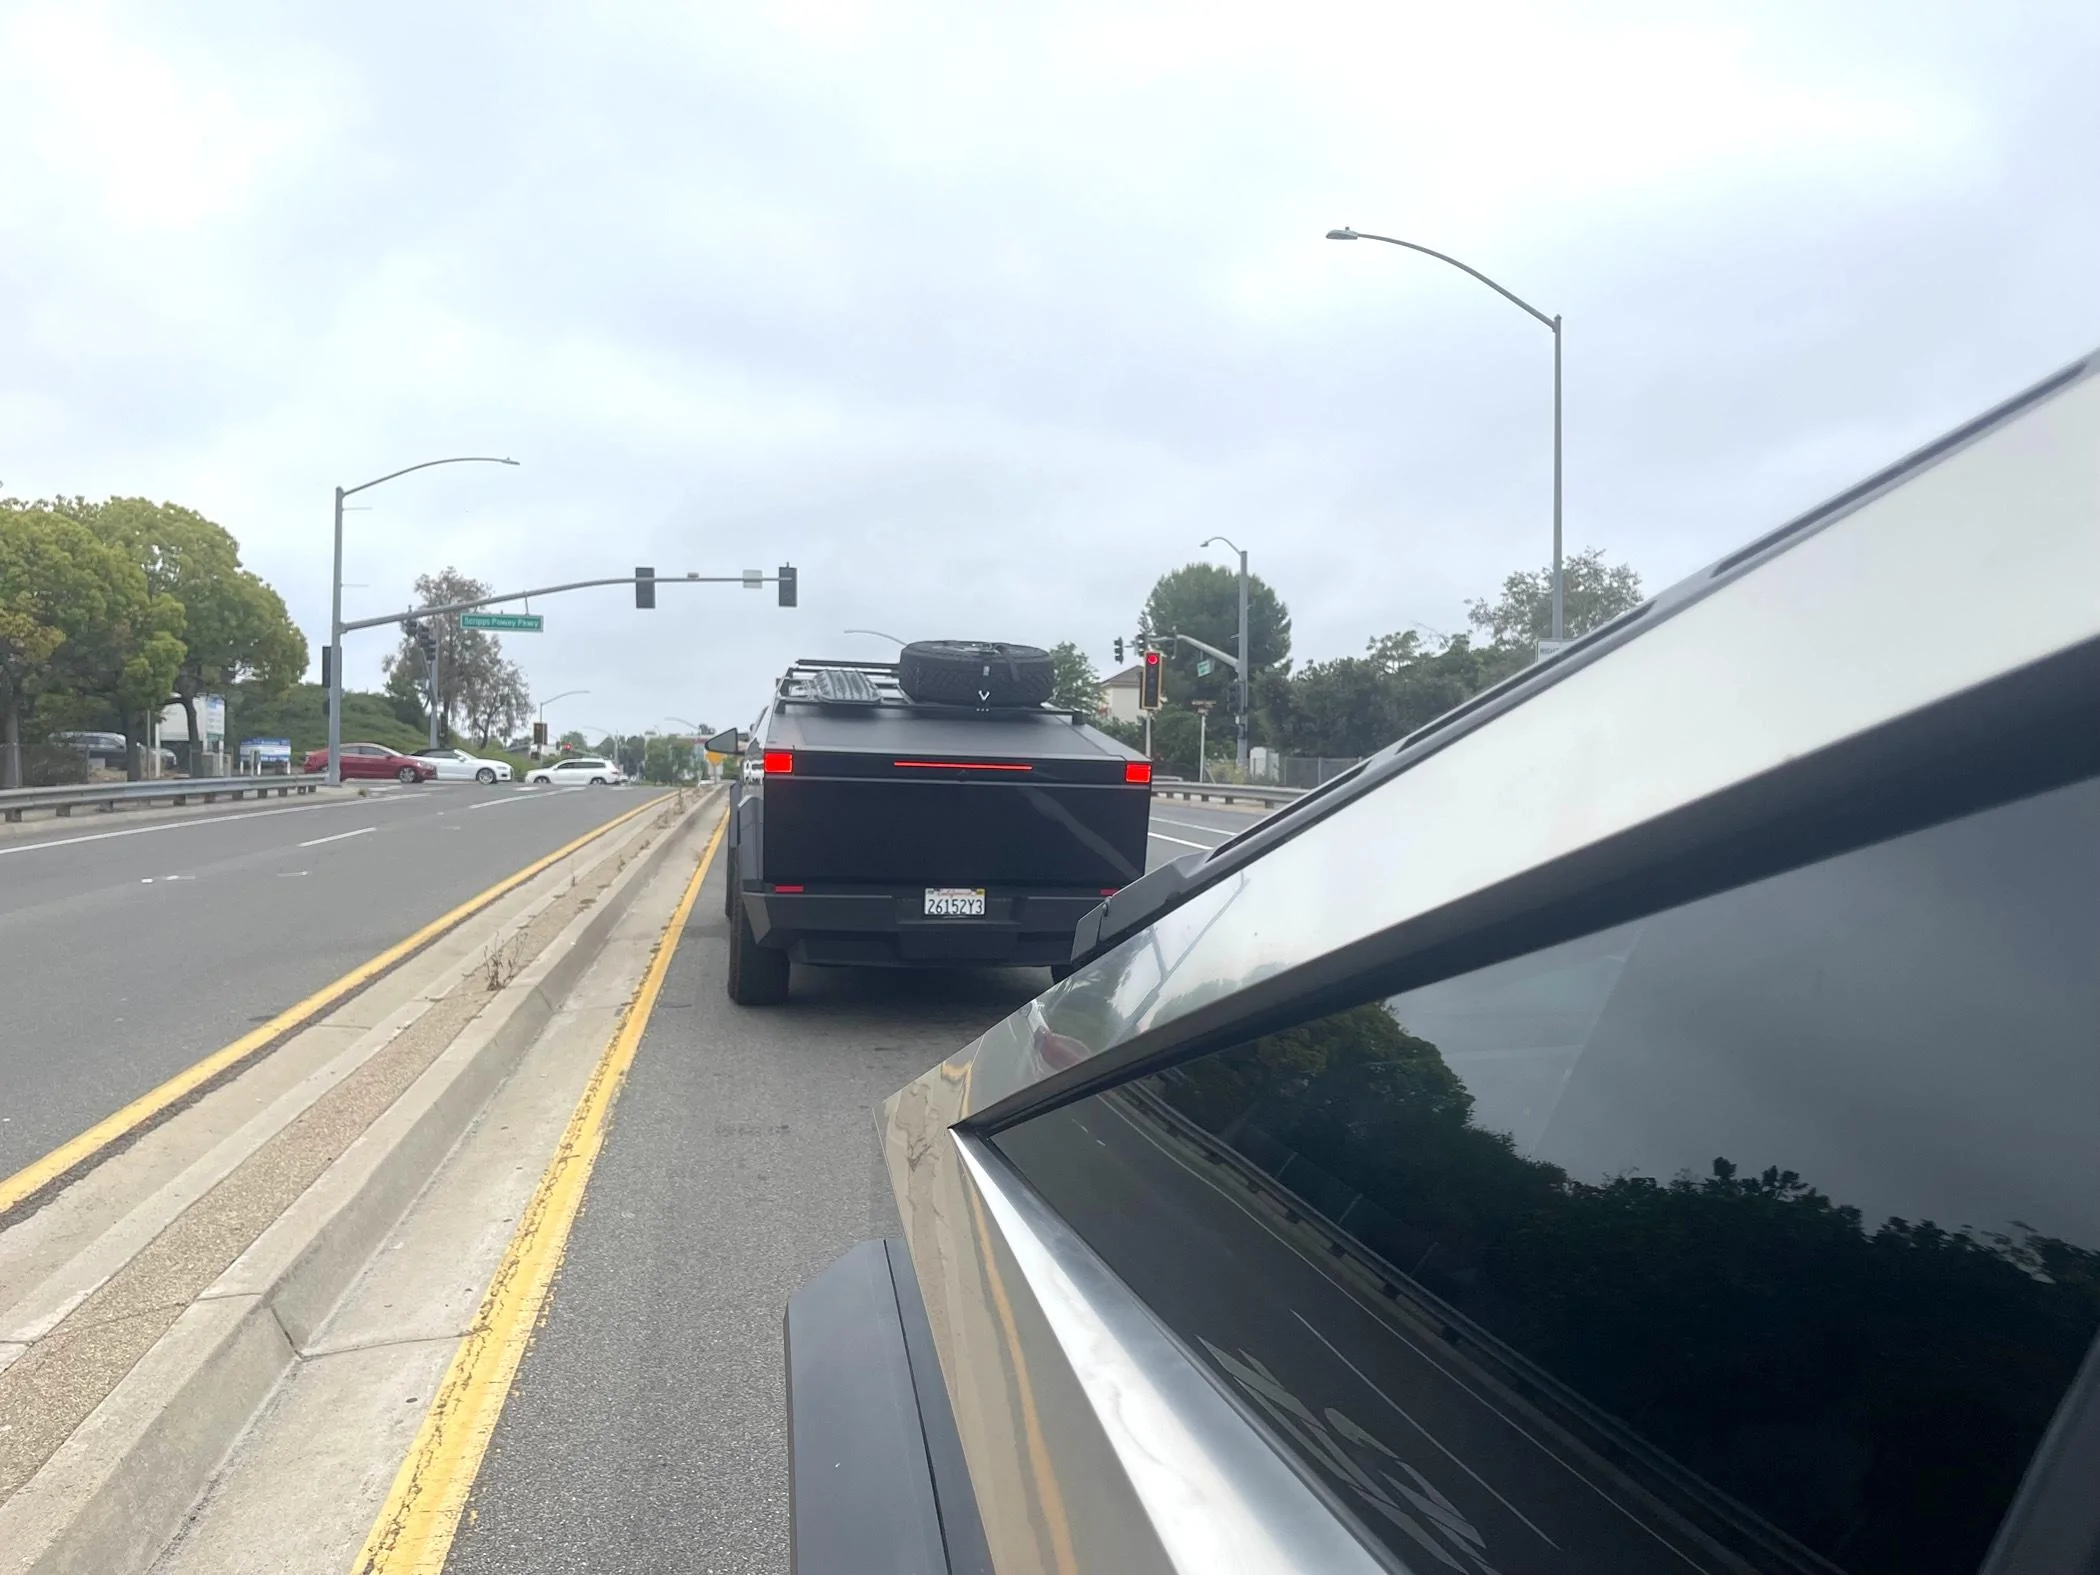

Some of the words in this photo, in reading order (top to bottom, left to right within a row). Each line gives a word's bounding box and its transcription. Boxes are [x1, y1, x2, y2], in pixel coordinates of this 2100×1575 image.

[464, 616, 491, 626] Scripps
[491, 617, 517, 627] Poway
[928, 898, 983, 914] 26152Y3
